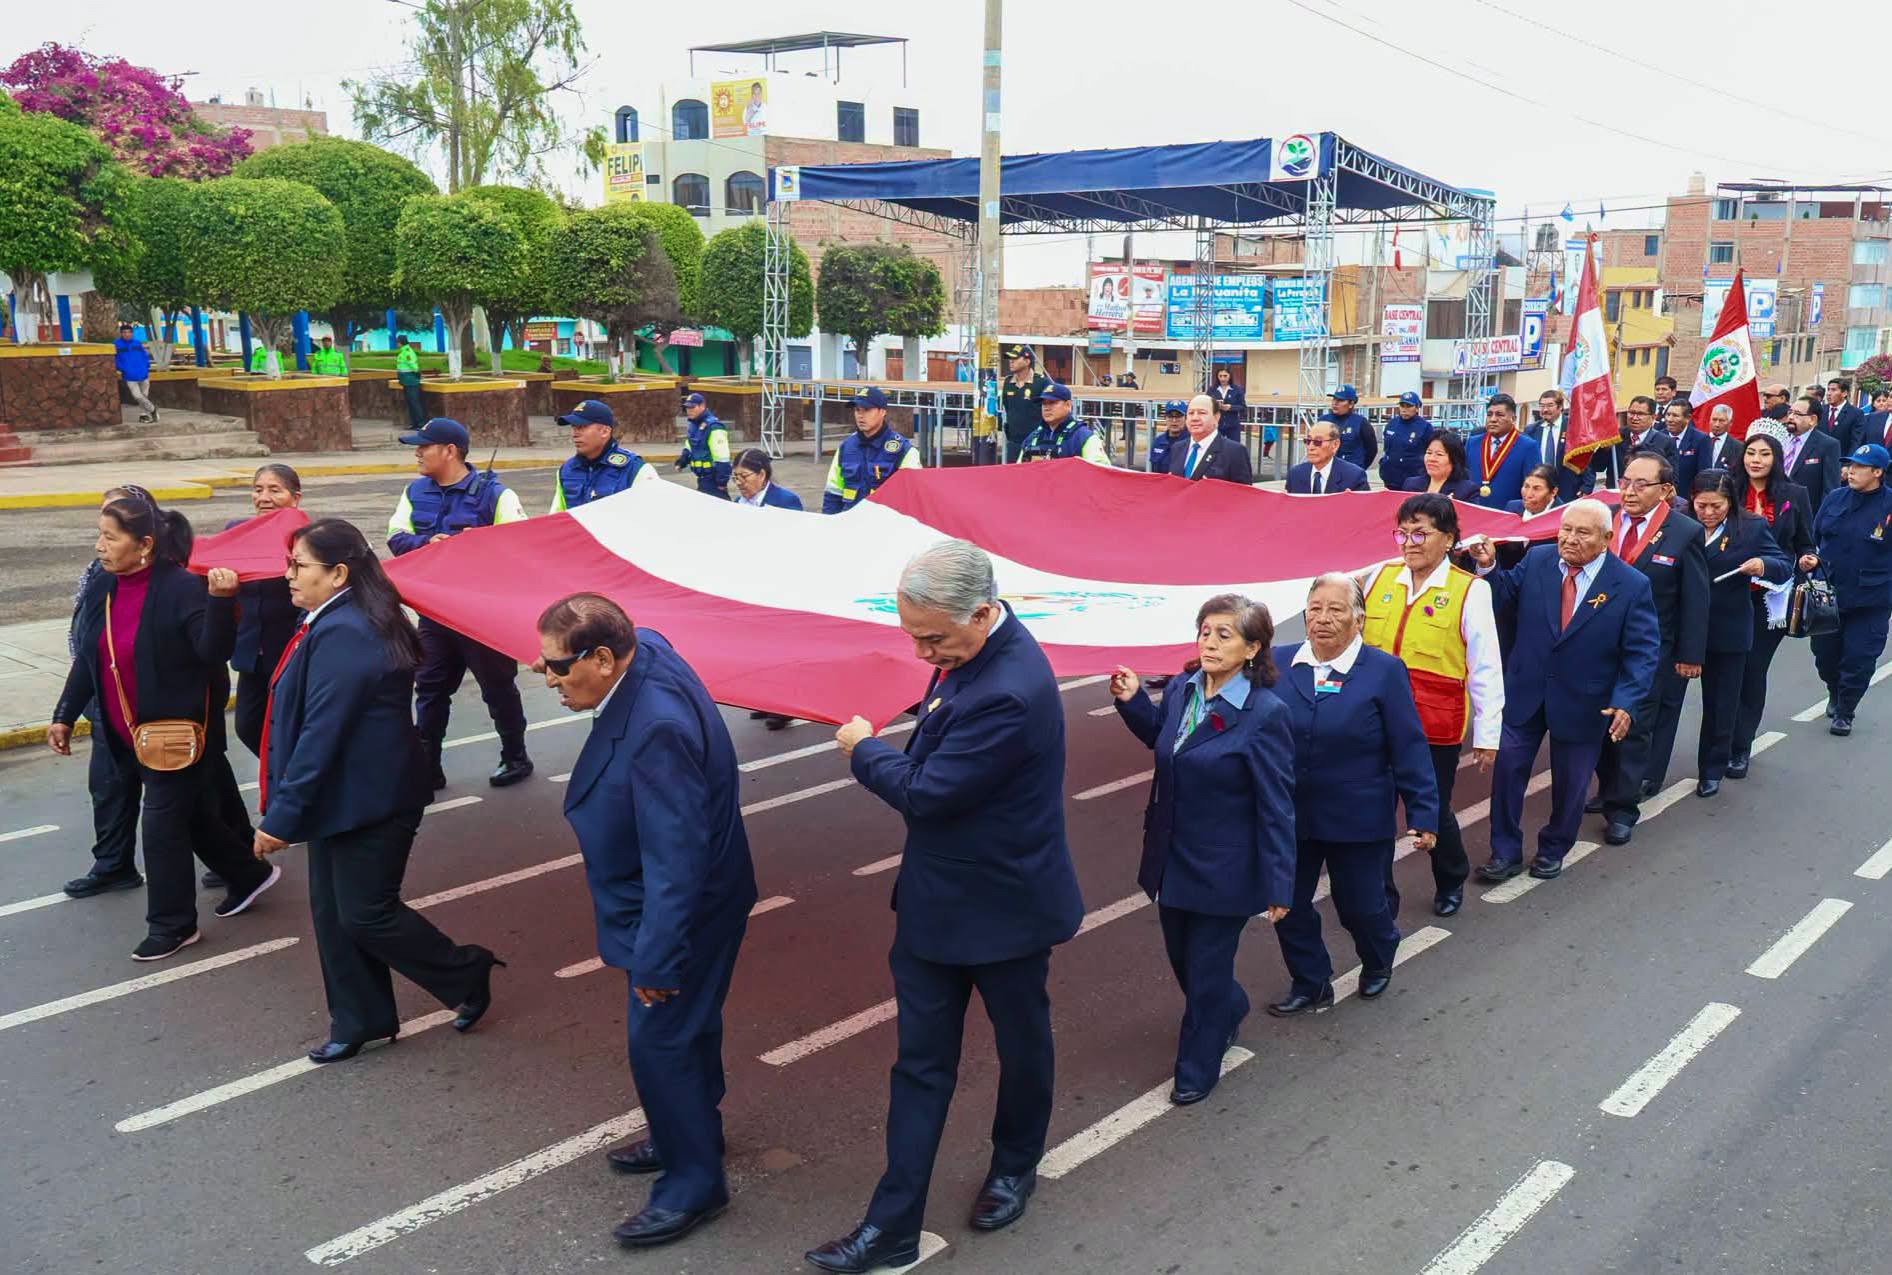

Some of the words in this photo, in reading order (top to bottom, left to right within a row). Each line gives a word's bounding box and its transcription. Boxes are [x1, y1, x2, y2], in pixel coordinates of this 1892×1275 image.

[1223, 276, 1264, 287] EMPLEOS
[1172, 287, 1189, 297] La
[1399, 310, 1422, 320] CENTRAL
[1491, 339, 1518, 353] CENTRAL
